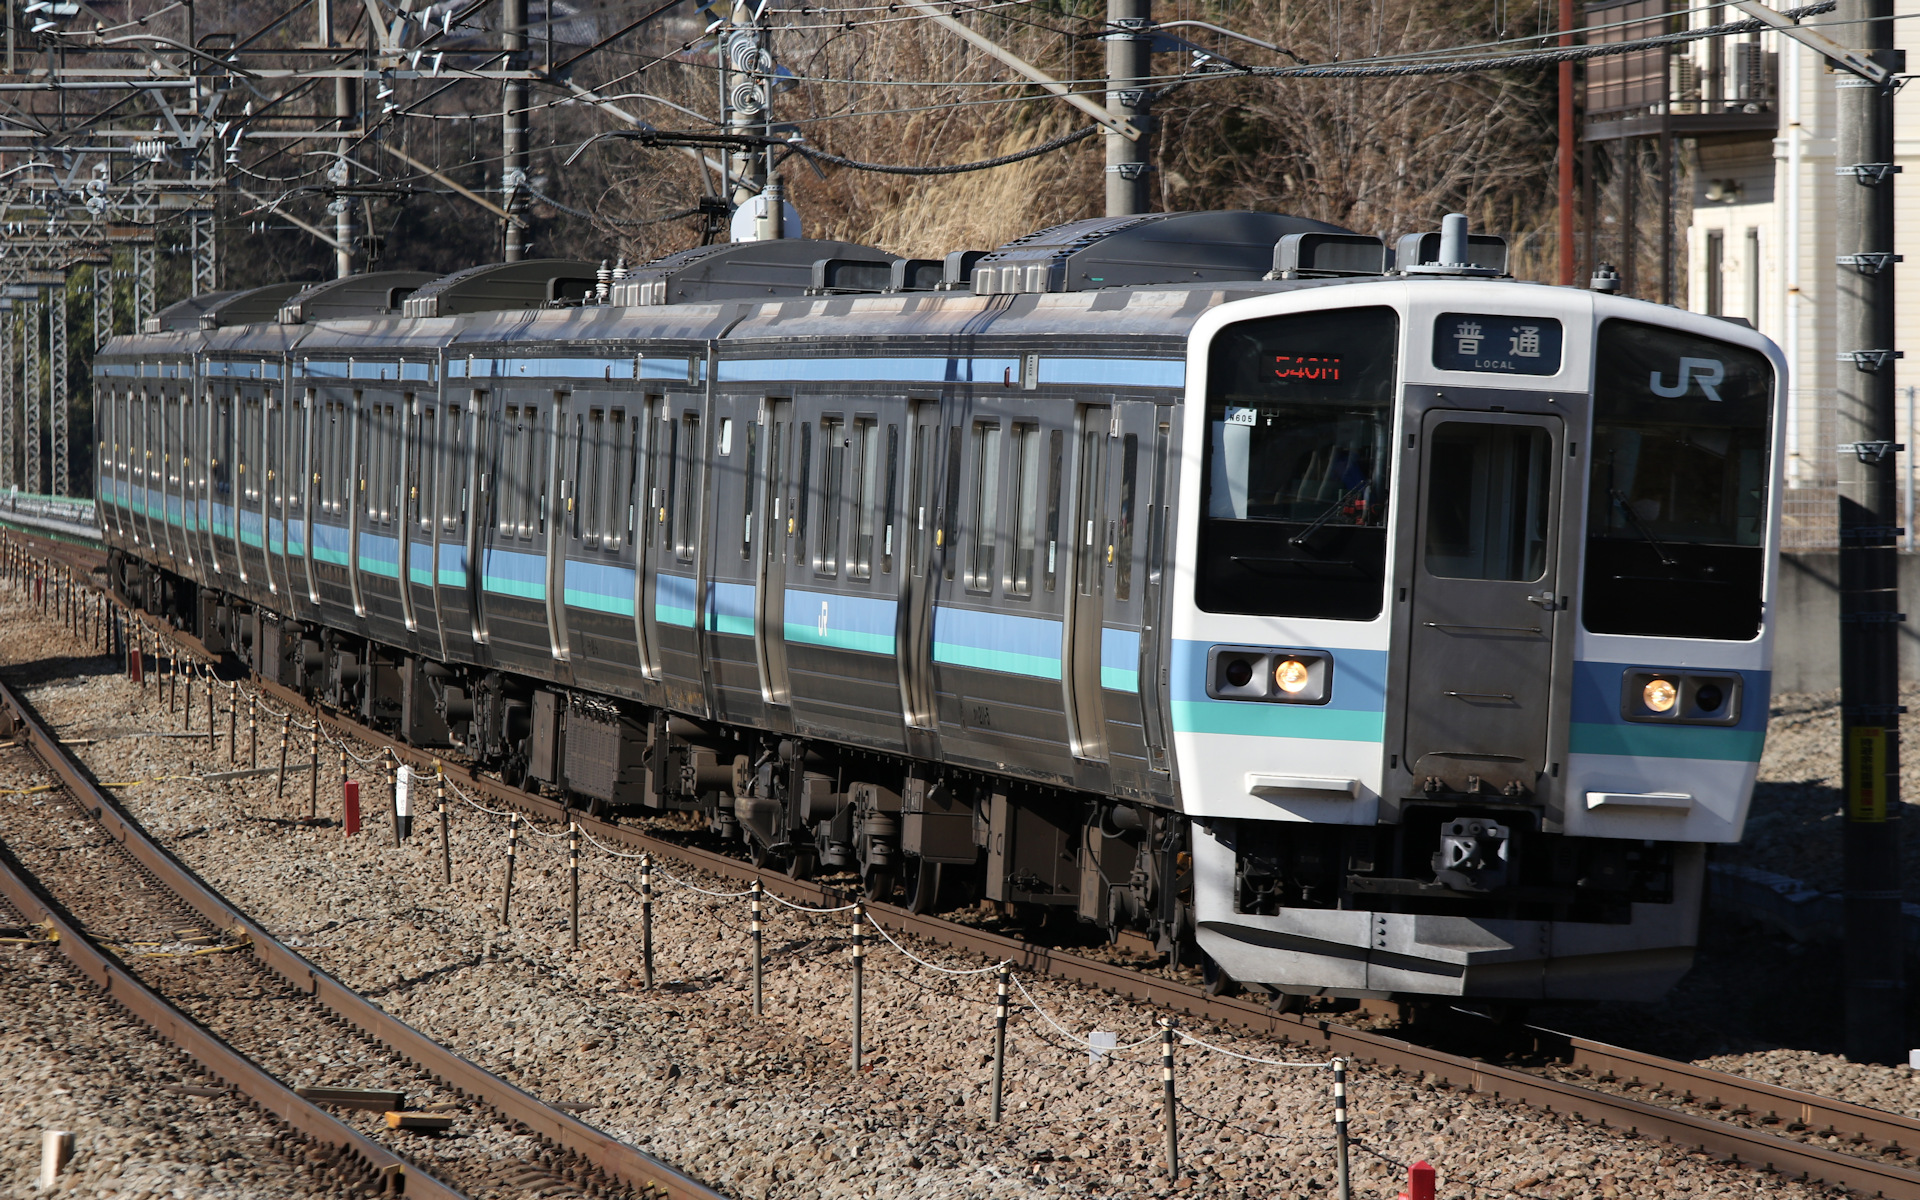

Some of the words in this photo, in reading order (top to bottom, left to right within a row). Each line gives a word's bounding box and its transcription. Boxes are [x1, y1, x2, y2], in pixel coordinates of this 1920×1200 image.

[1453, 321, 1541, 358] 普通
[1475, 359, 1516, 370] LOCAL
[1649, 356, 1725, 402] JR
[1229, 413, 1253, 423] N605
[818, 601, 828, 637] JR
